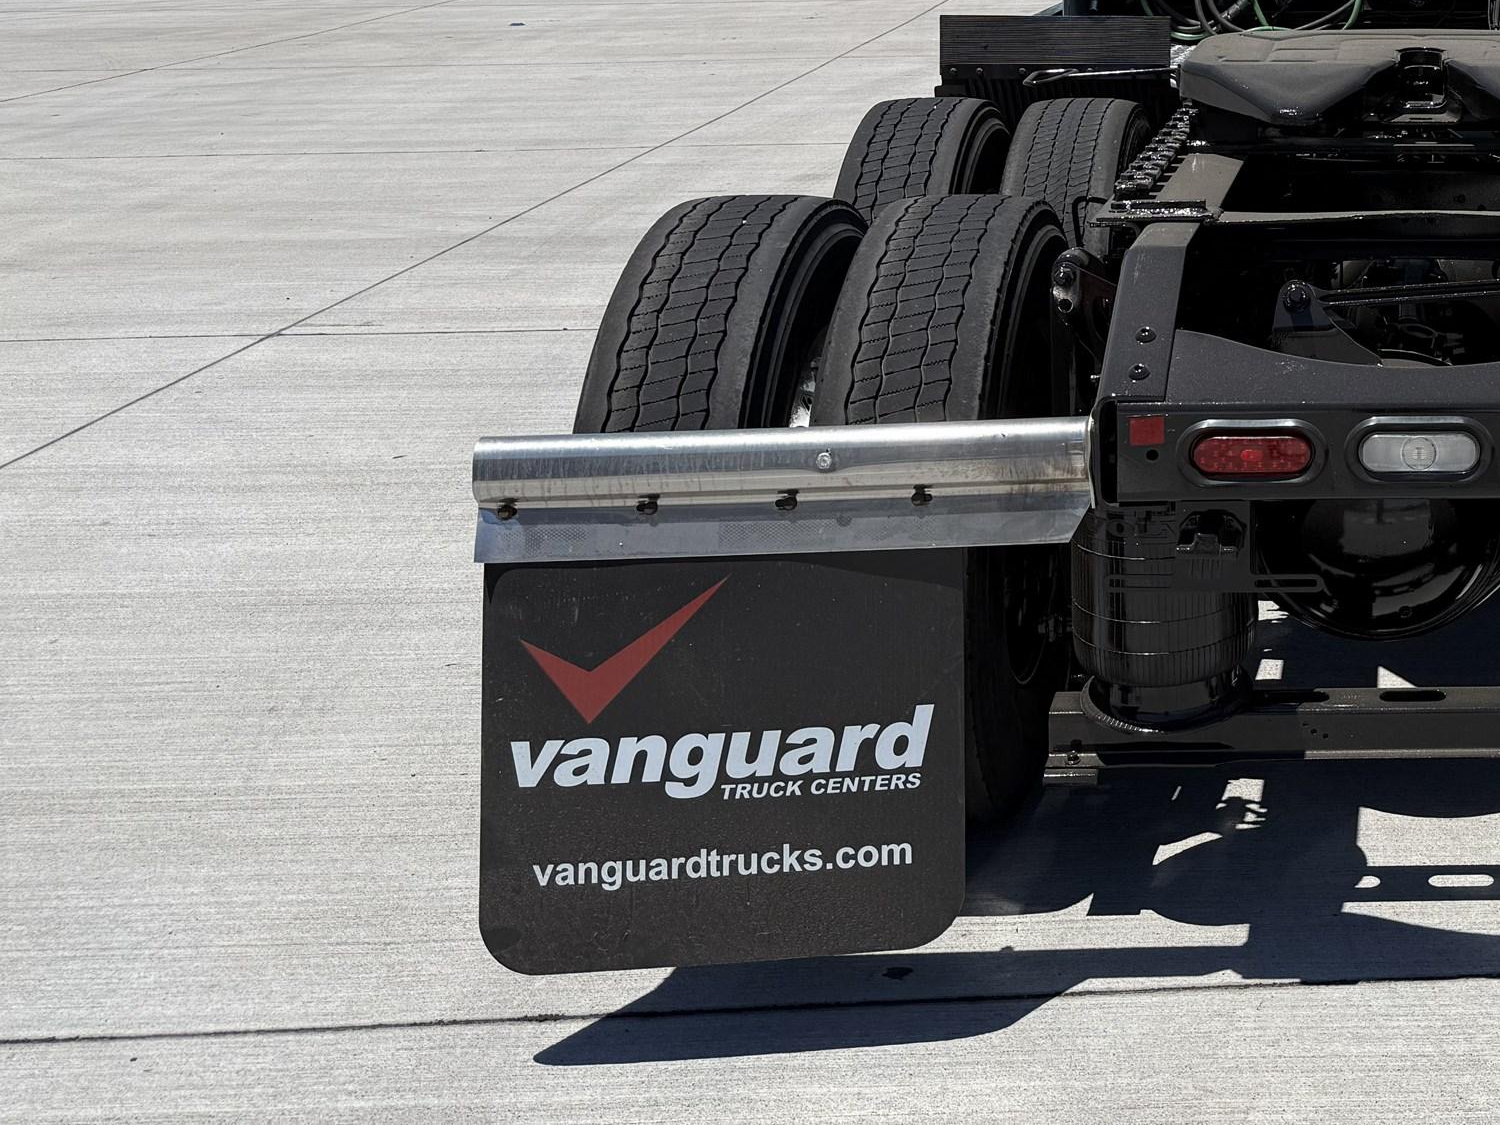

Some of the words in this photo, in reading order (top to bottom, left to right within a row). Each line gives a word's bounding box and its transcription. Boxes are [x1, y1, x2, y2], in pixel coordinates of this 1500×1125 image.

[510, 703, 935, 799] vanguard
[720, 779, 803, 800] TRUCK
[810, 772, 922, 795] CENTERS
[532, 842, 913, 891] vanguardtrucks.com
